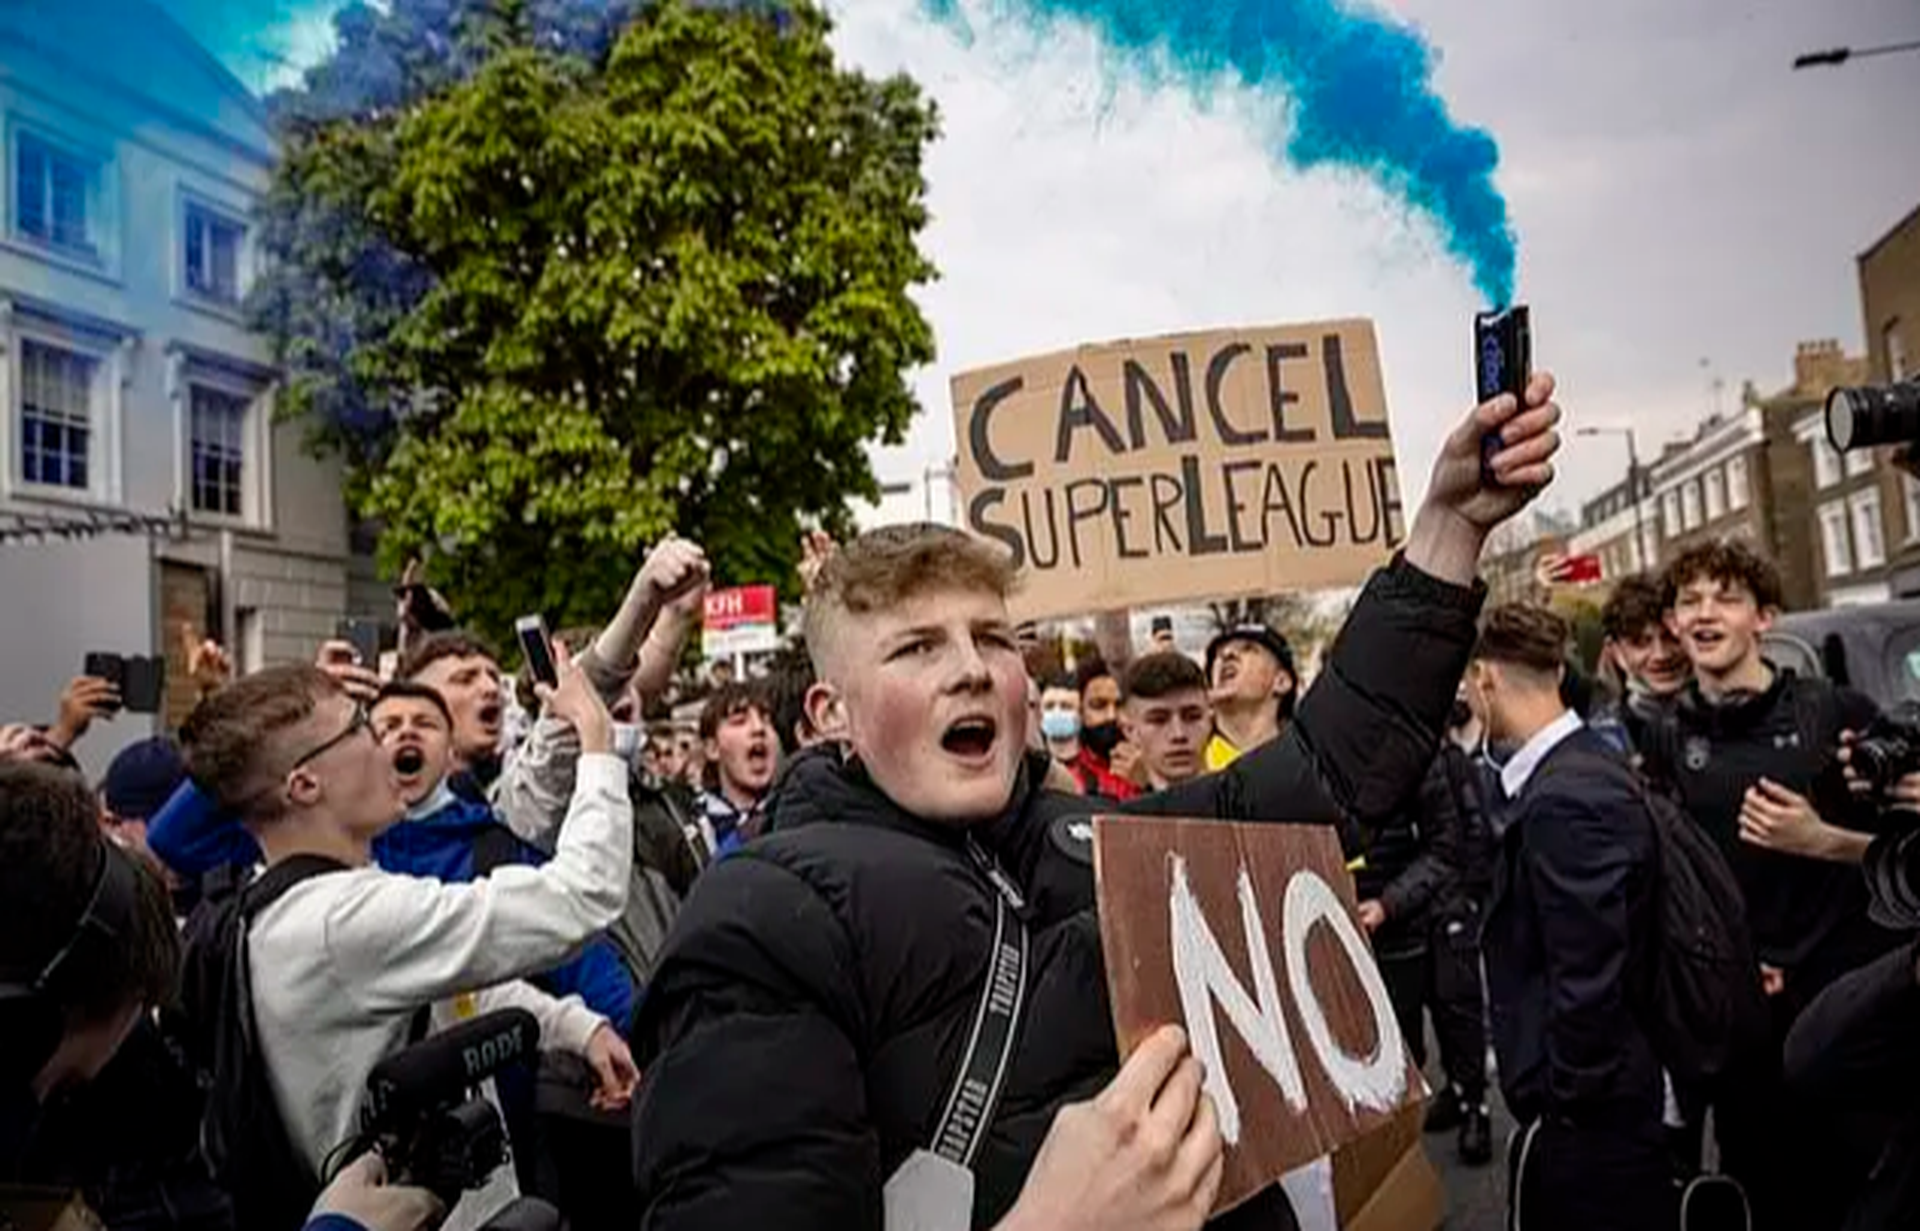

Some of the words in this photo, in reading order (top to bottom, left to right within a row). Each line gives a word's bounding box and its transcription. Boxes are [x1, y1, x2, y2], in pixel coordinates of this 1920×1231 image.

[968, 333, 1390, 482] CANCEL
[969, 454, 1404, 570] SUPERLEAGUE
[1167, 852, 1408, 1146] NO
